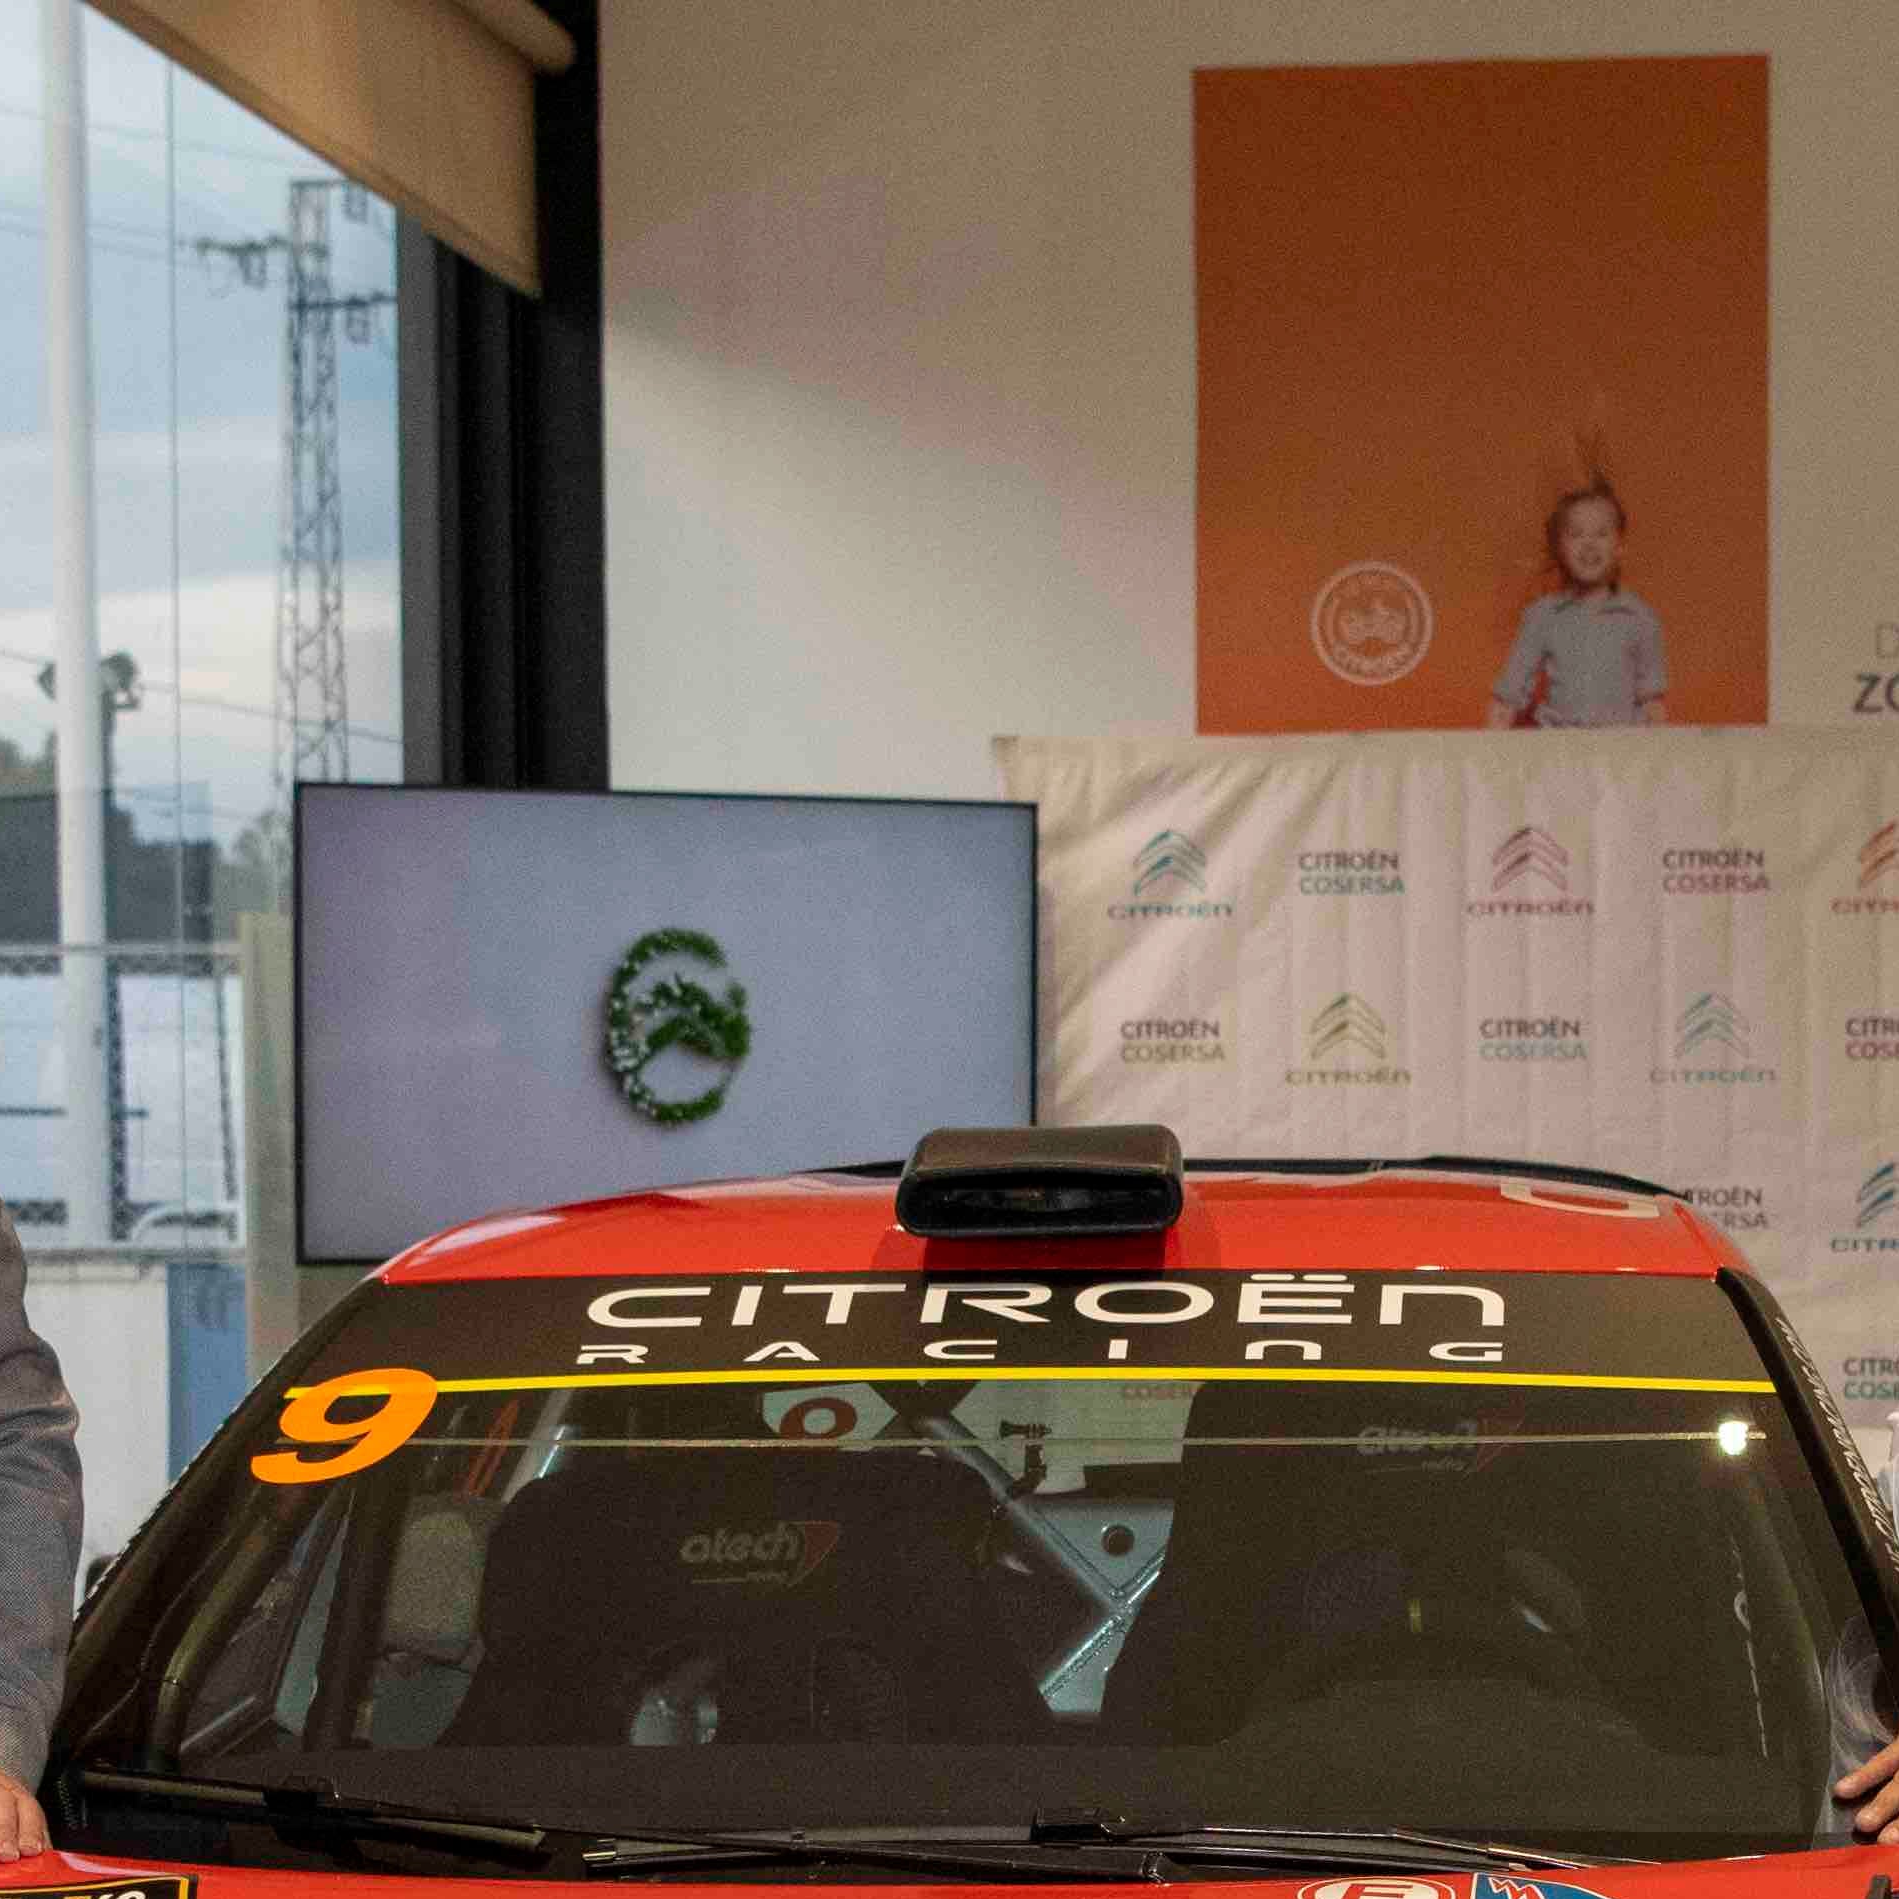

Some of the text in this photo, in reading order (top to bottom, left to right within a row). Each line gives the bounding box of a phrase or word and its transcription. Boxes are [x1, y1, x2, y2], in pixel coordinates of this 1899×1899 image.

[1298, 847, 1400, 872] CITROËN
[1662, 844, 1765, 869] CITROËN
[1300, 875, 1406, 897] COSERSA
[1662, 873, 1772, 895] COSERSA
[1121, 1015, 1221, 1040] CITROËN
[1479, 1014, 1581, 1039] CITROËN
[1121, 1043, 1227, 1064] COSERSA
[1479, 1040, 1588, 1062] COSERSA
[586, 1273, 1505, 1328] CITROËN
[575, 1338, 1505, 1365] RACING
[250, 1367, 439, 1485] 9
